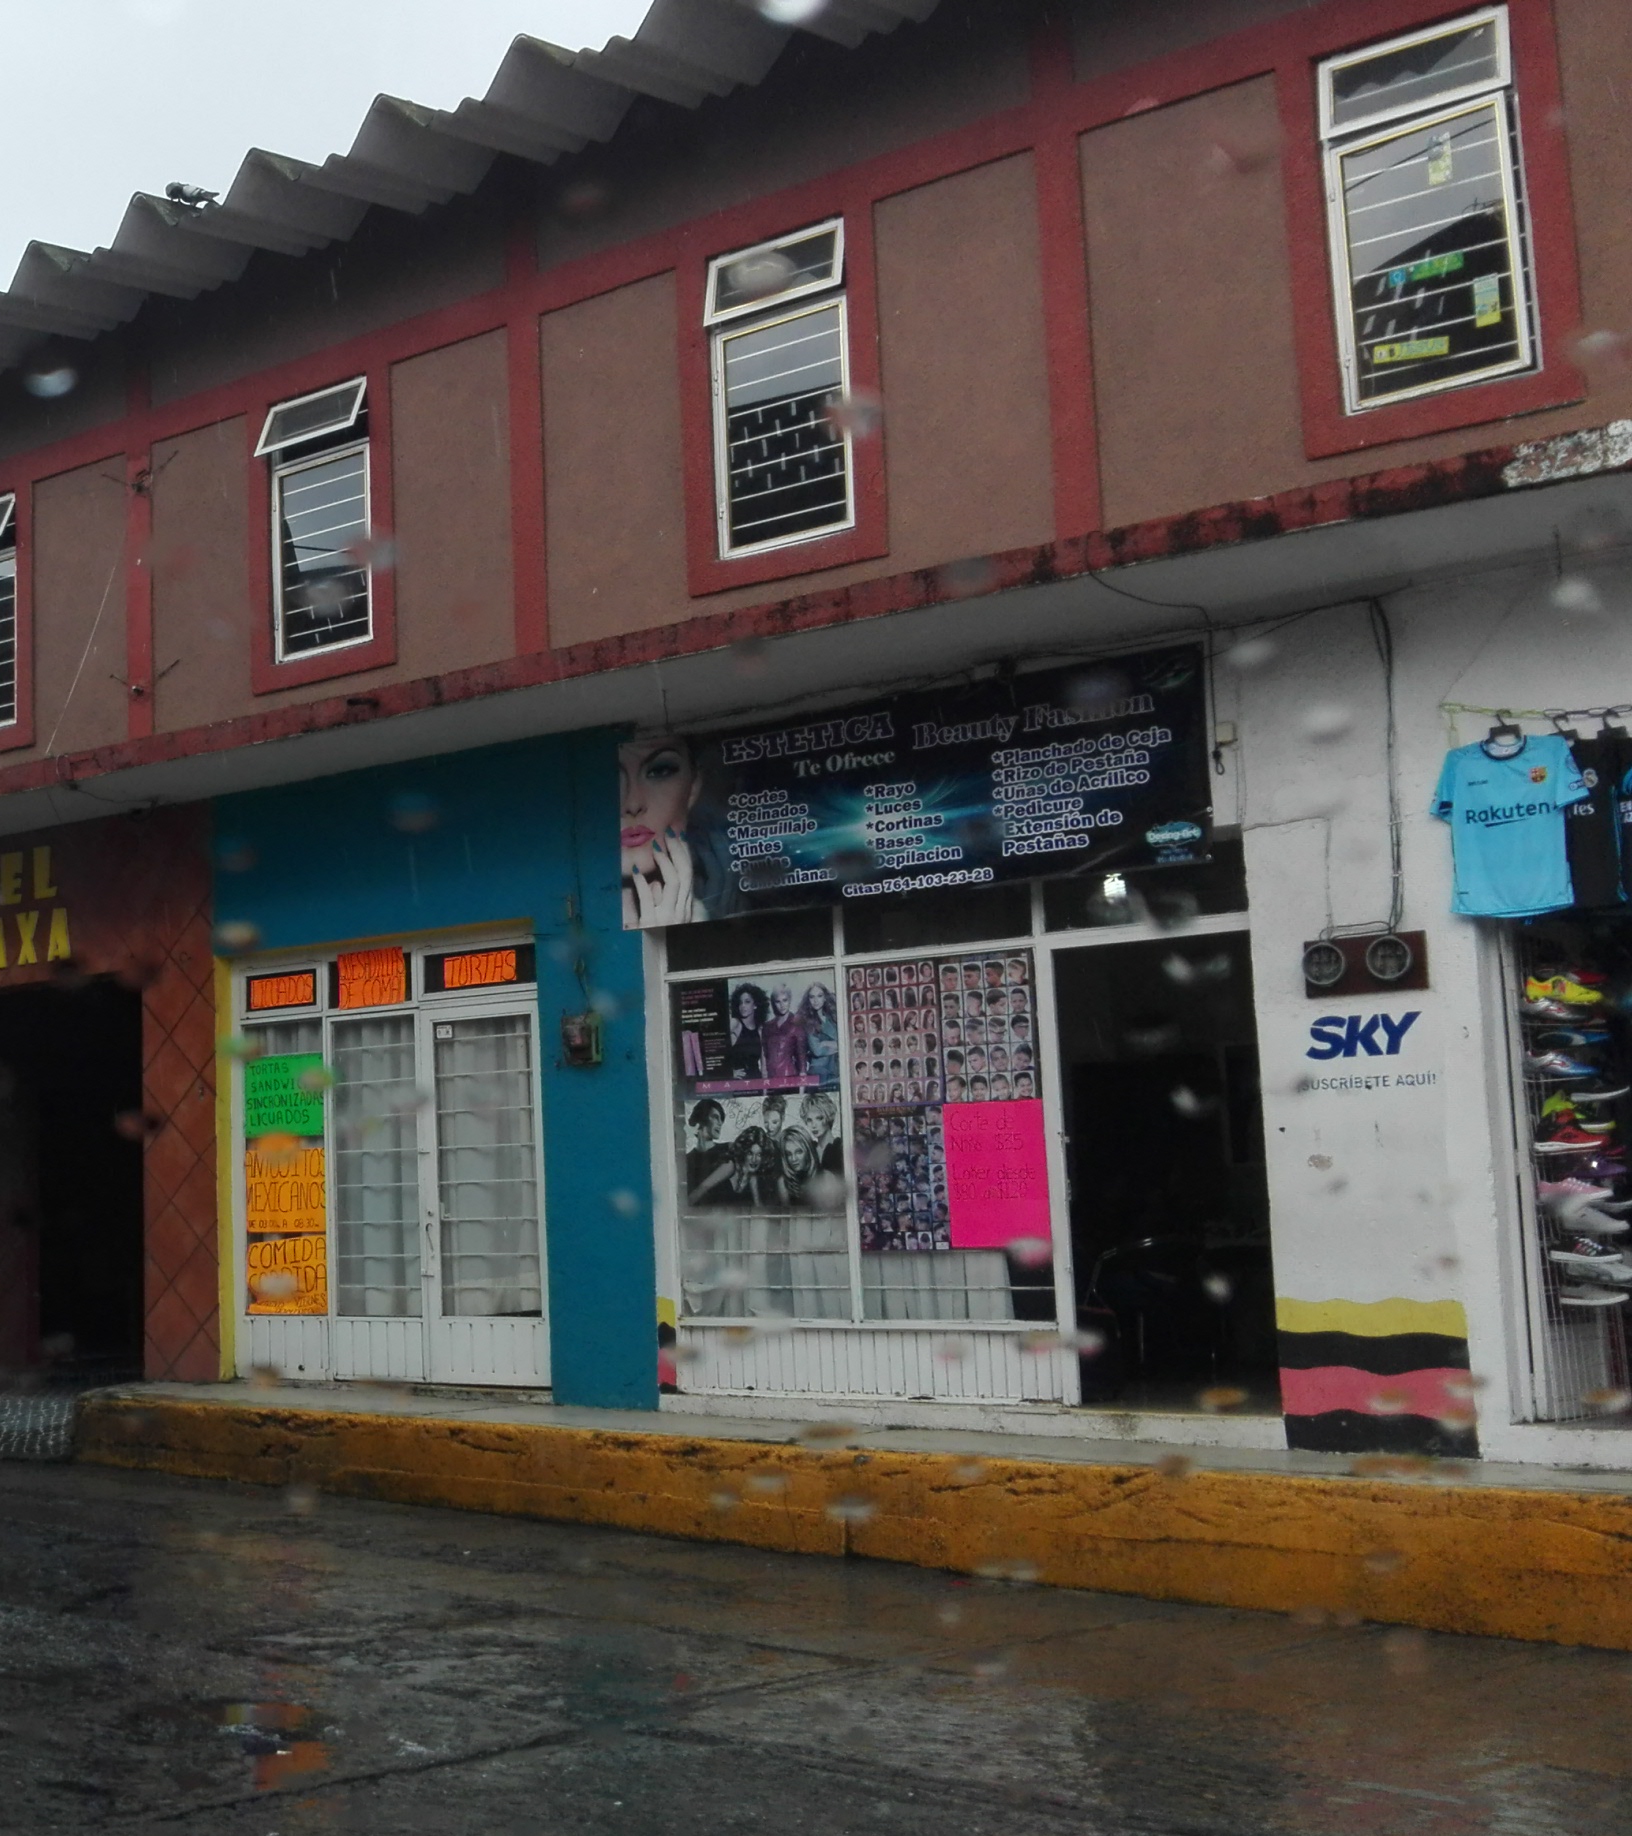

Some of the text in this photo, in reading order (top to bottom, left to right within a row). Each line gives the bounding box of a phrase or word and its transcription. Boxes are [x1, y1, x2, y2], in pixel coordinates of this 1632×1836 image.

[723, 711, 895, 765] ESTETICA
[911, 713, 1019, 750] Beauty
[1002, 726, 1172, 766] Planchado de Ceja
[793, 748, 896, 779] Te Ofrece
[1002, 749, 1150, 785] Rizo de Pestaña
[738, 790, 788, 807] Cortes
[874, 782, 916, 800] Rayo
[1003, 783, 1048, 801] Uñas
[1050, 779, 1075, 794] de
[736, 804, 808, 823] Peinados
[874, 799, 922, 816] Luces
[1002, 797, 1084, 819] Pedicure
[1465, 800, 1551, 824] Rakuten
[736, 818, 818, 841] Maquillaje
[874, 814, 944, 833] Cortinas
[1003, 808, 1124, 838] Extensión de
[737, 841, 783, 858] Tintes
[875, 834, 924, 851] Bases
[1002, 833, 1090, 857] Pestañas
[876, 845, 963, 869] Depilacion
[739, 868, 838, 892] Caornianas
[842, 867, 994, 897] Citas 764-103-23-28
[445, 951, 516, 987] TORTAS
[1305, 1010, 1423, 1061] SKY
[249, 1062, 289, 1076] TORTAS
[1395, 1070, 1437, 1087] AQUÍ!
[250, 1109, 310, 1126] LICUADOS
[248, 1237, 326, 1268] COMIDA
[249, 1263, 327, 1294] CIDA
